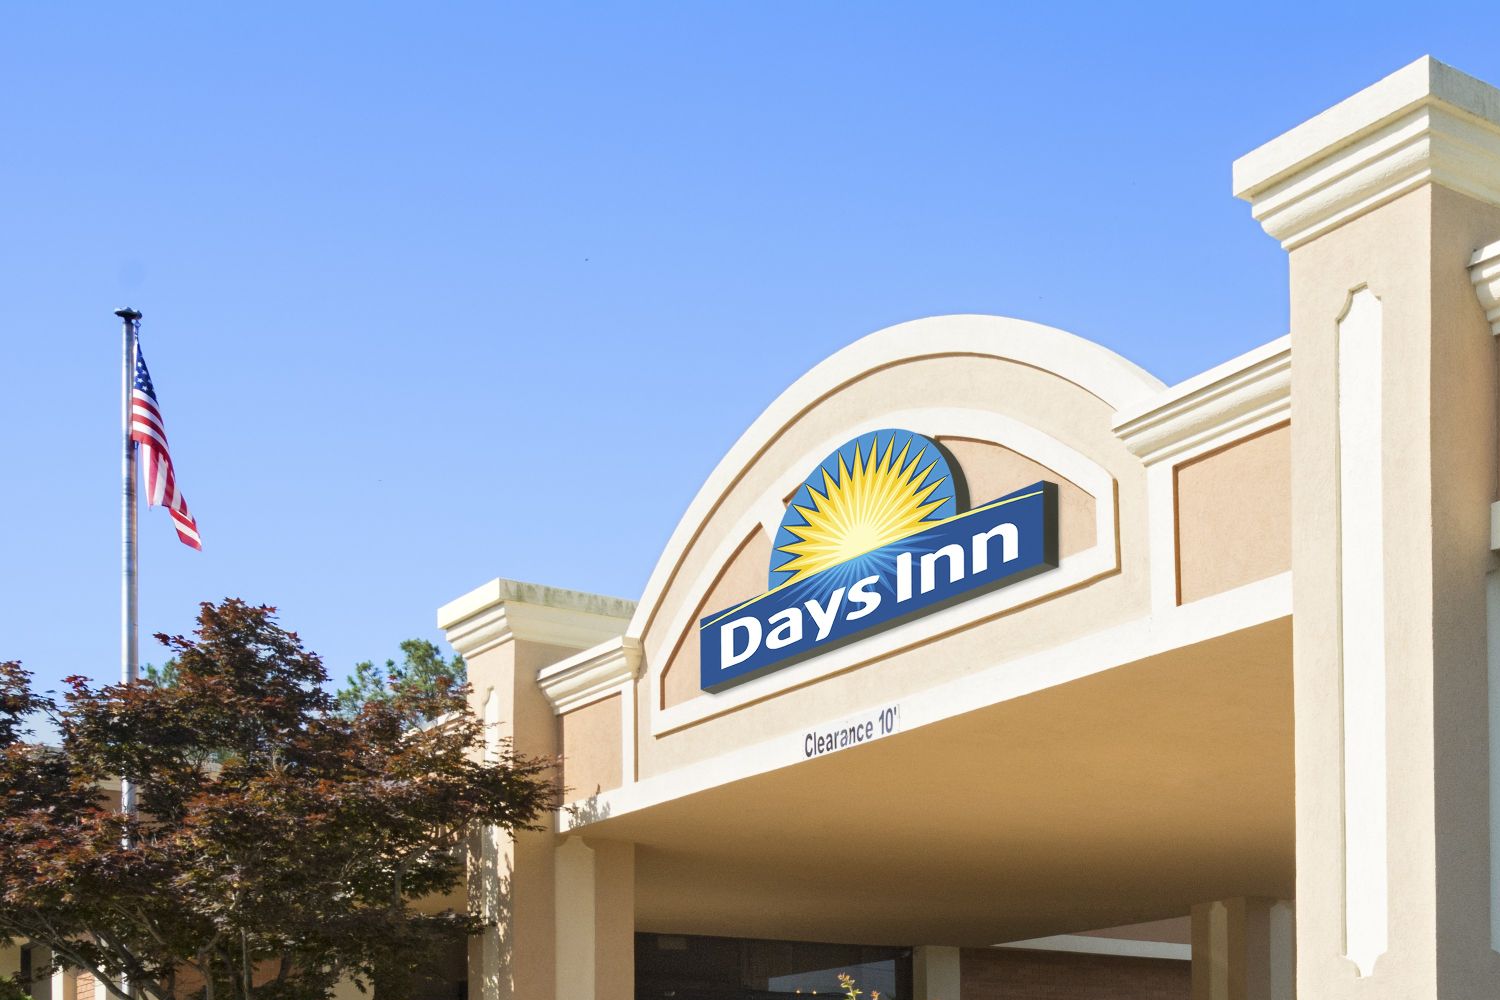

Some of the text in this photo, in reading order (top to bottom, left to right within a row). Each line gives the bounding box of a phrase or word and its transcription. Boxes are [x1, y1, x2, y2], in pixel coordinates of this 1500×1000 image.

[720, 522, 1019, 670] Days Inn
[804, 720, 874, 758] Clearance
